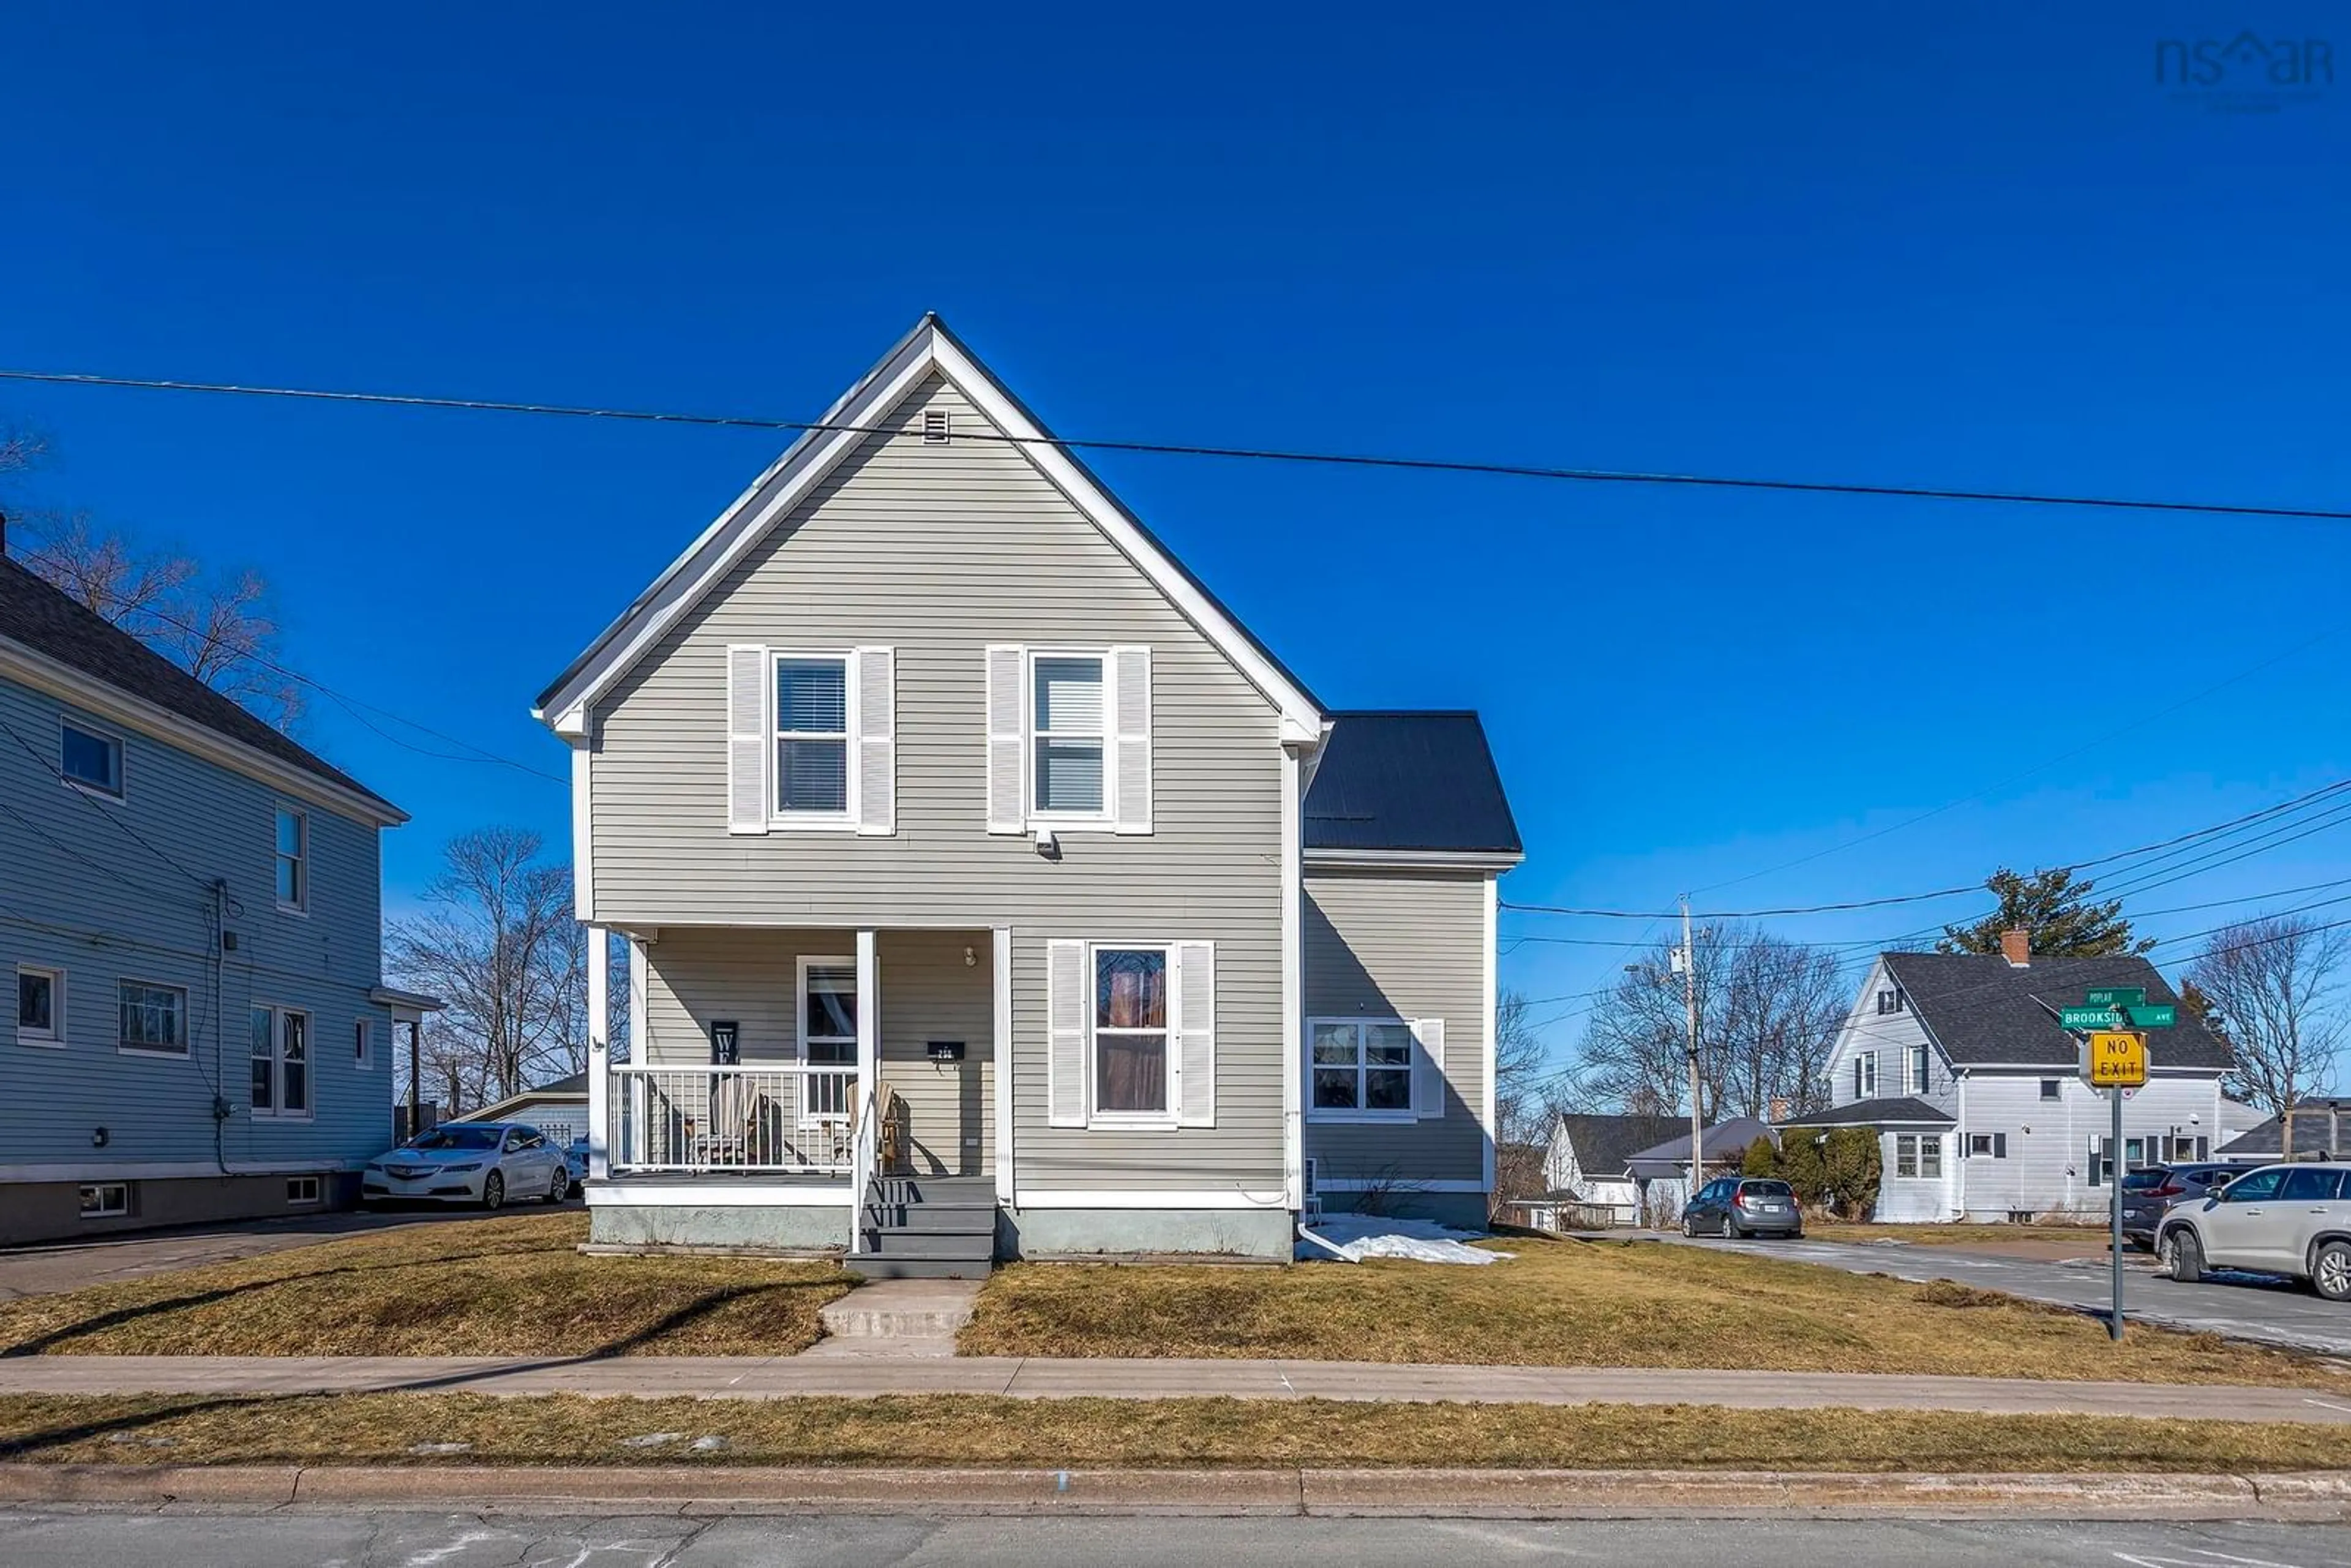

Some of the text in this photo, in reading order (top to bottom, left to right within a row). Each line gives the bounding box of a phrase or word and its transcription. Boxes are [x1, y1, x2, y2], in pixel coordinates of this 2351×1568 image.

[2065, 1012, 2171, 1024] BROOKSIDE AVE
[2107, 1040, 2128, 1054] NO
[2101, 1062, 2136, 1076] EXIT
